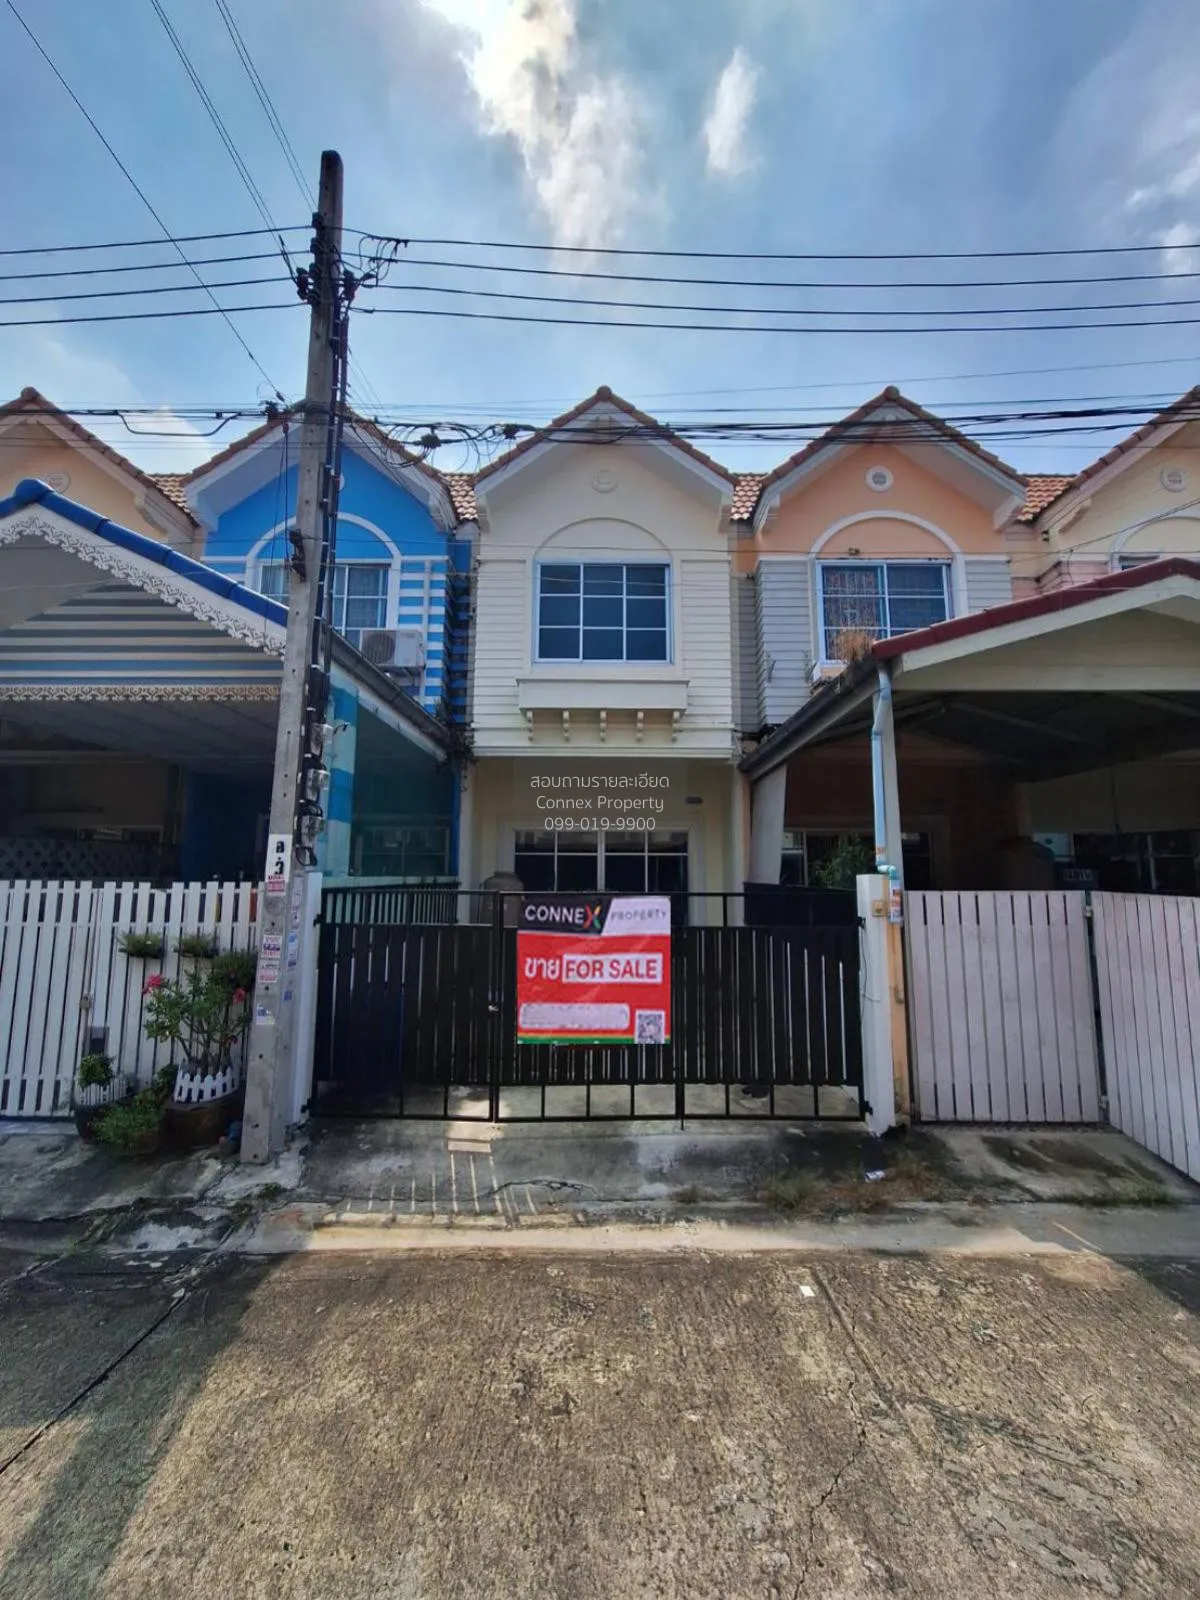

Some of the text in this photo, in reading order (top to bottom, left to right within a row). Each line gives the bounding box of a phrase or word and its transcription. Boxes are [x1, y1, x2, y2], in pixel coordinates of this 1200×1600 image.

[524, 904, 667, 929] CONNEX PROPERTY
[524, 957, 658, 980] ขาย FOR SALE
